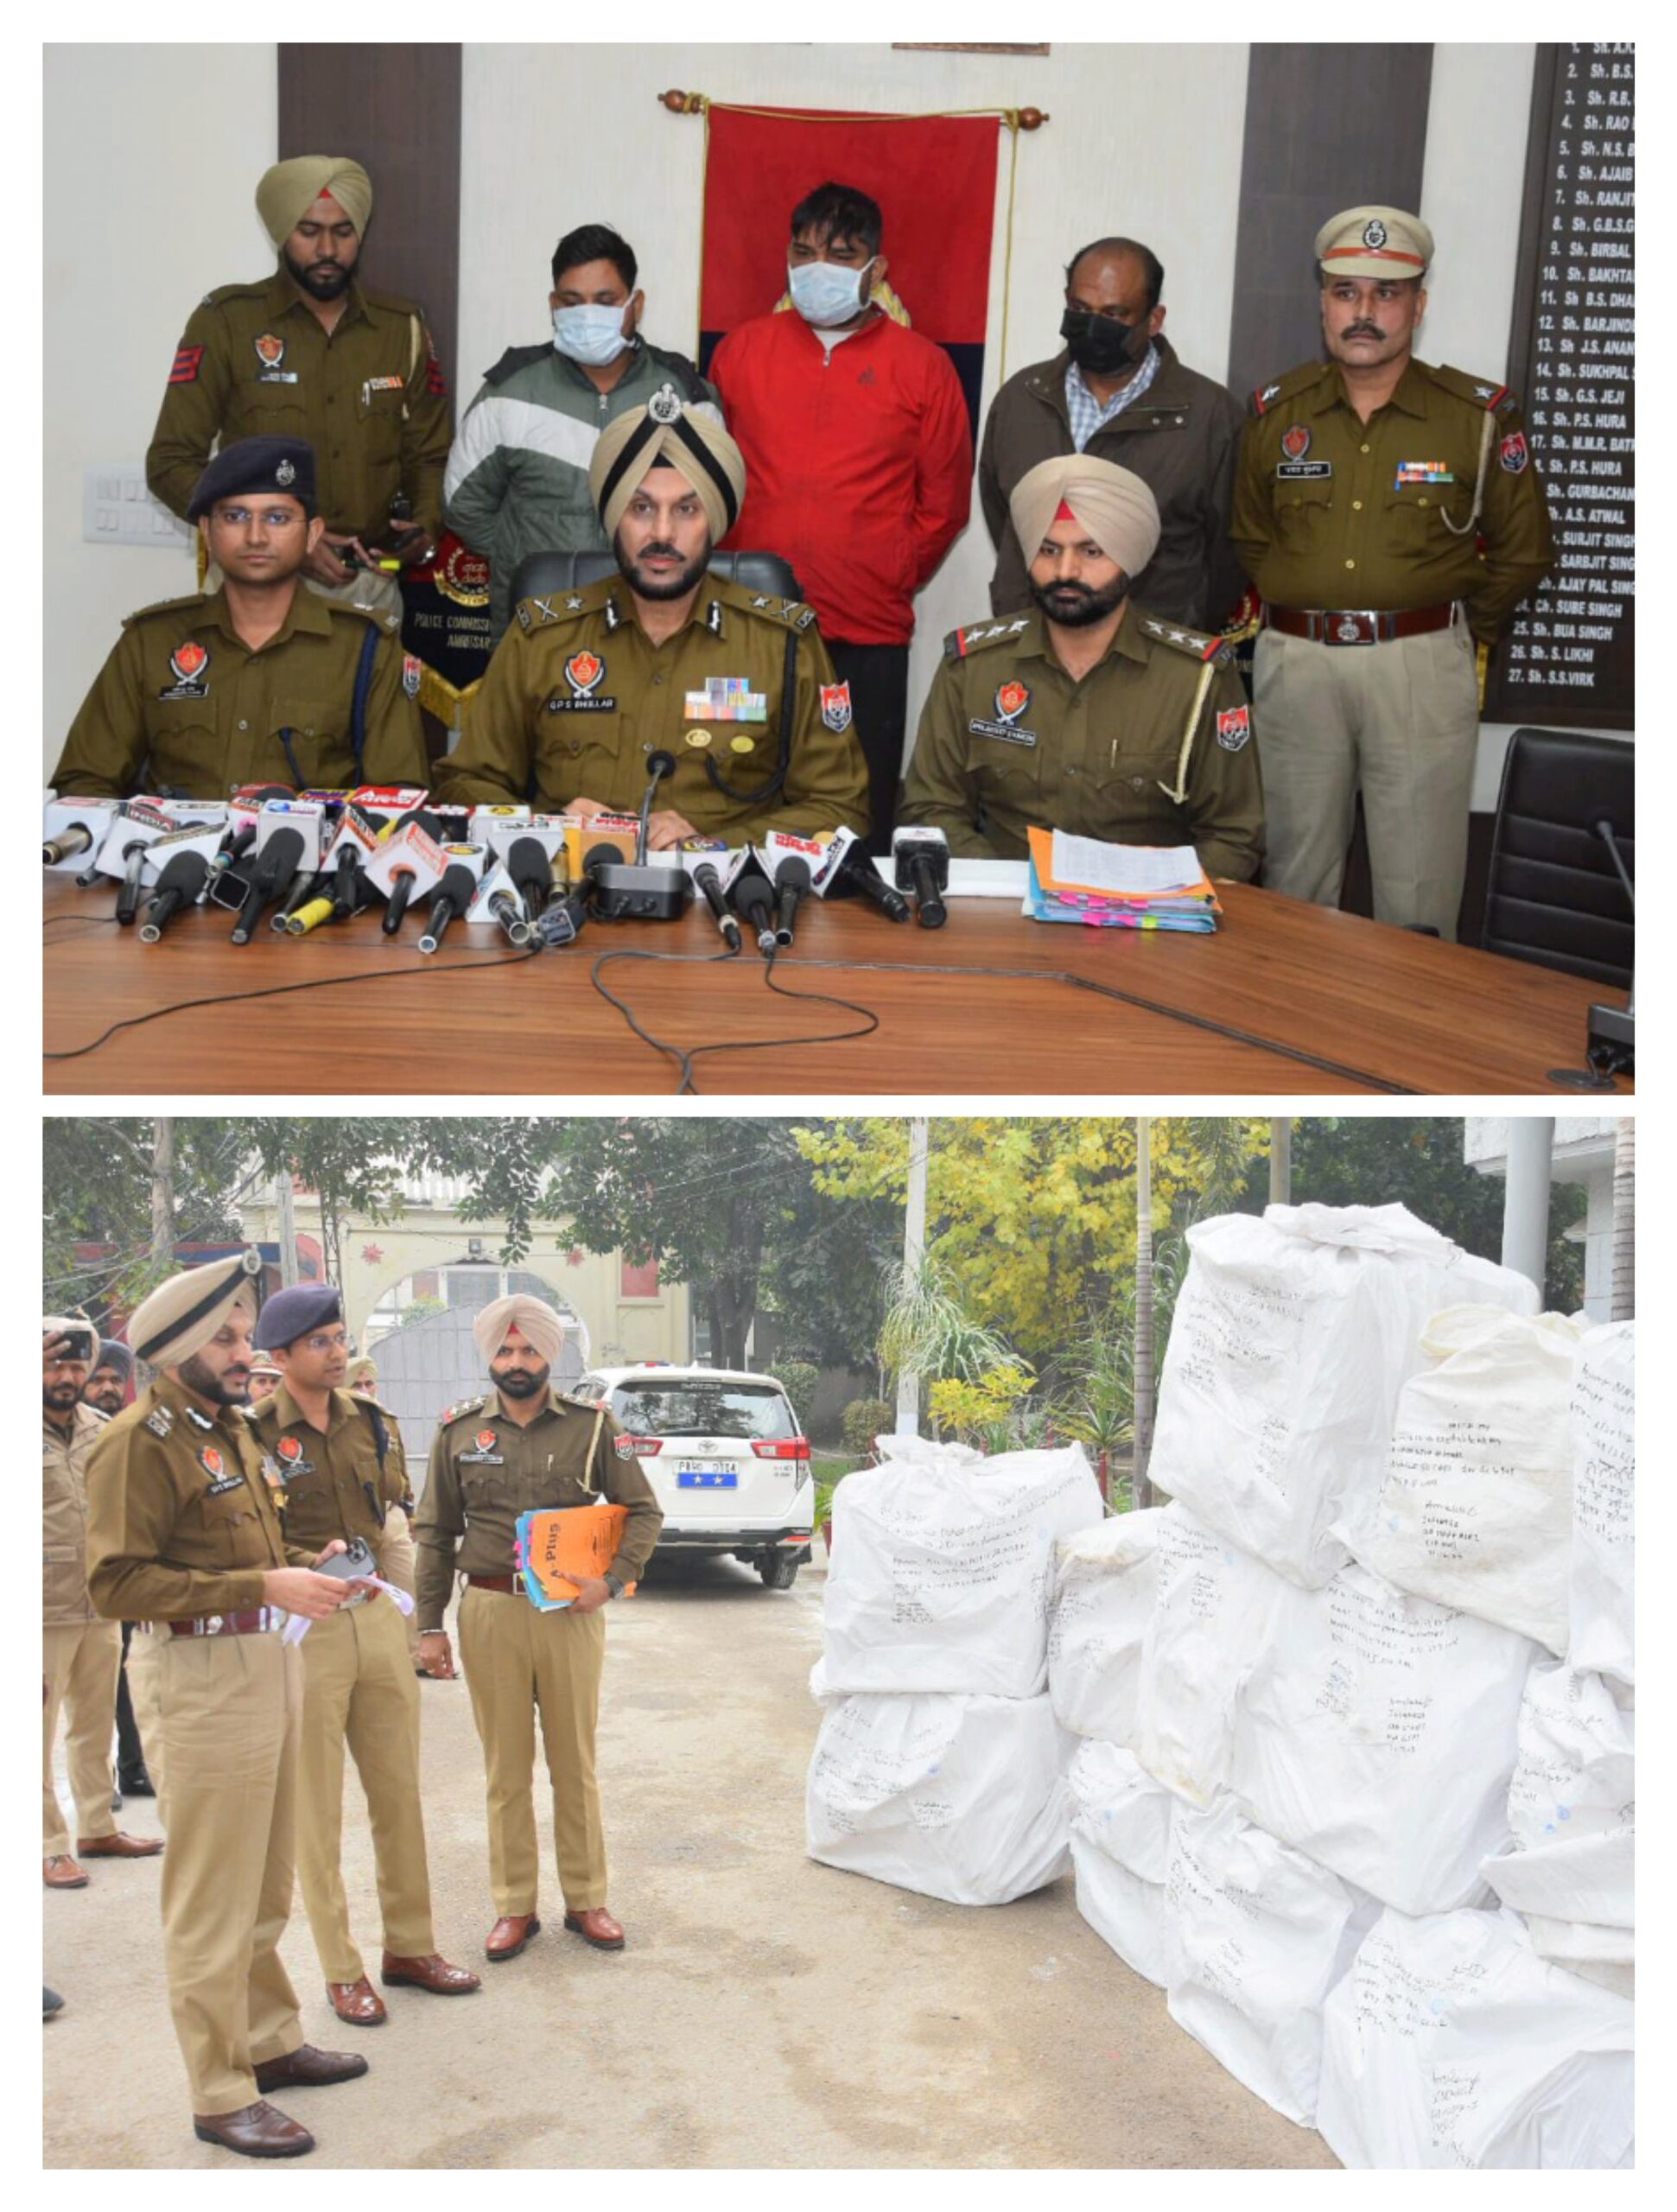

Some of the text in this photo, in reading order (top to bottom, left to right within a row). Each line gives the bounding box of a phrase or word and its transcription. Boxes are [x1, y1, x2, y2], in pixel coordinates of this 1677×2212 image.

[1567, 62, 1634, 79] 2. Sh. B.S.
[1565, 89, 1631, 105] 3. Sh. R.B.
[1561, 114, 1629, 130] 4. Sh. RAO
[1559, 139, 1570, 155] 5.
[1581, 140, 1599, 156] Sh.
[1603, 141, 1624, 156] N.S.
[1556, 164, 1634, 181] 6. Sh. AJAIB
[1555, 189, 1566, 204] 7.
[1575, 189, 1594, 205] Sh.
[1553, 215, 1562, 231] 8.
[1572, 216, 1591, 232] Sh.
[1550, 240, 1631, 258] 9. Sh. BIRBAL
[1542, 266, 1635, 283] 10. Sh. BAKHTA
[1540, 290, 1557, 305] 11.
[1585, 291, 1607, 307] B.S.
[1539, 315, 1554, 330] 12.
[1562, 315, 1579, 331] Sh.
[1537, 337, 1553, 353] 13.
[1580, 339, 1600, 354] J.S.
[1536, 361, 1552, 378] 14.
[1558, 362, 1576, 378] Sh.
[1534, 386, 1550, 401] 15.
[1555, 387, 1573, 403] Sh.
[1576, 388, 1598, 404] G.S.
[1553, 411, 1572, 427] Sh.
[1573, 412, 1593, 428] P.S.
[1530, 435, 1547, 449] 17.
[1552, 435, 1570, 449] Sh.
[1549, 459, 1567, 474] Sh.
[1570, 460, 1589, 474] P.S.
[1547, 483, 1565, 499] Sh.
[1565, 507, 1586, 523] A.S.
[1588, 508, 1627, 524] ATWAL
[1563, 531, 1602, 547] SURJIT
[1560, 554, 1607, 569] SARBJIT
[1558, 576, 1586, 592] AJAY
[1588, 578, 1608, 594] PAL
[1555, 599, 1585, 615] SUBE
[1587, 601, 1623, 618] SINGH
[415, 613, 443, 628] POLICE
[1512, 620, 1613, 641] 25. Sh. BUA SINGH
[1510, 645, 1594, 663] 26. Sh. S. LIKHI
[1508, 668, 1524, 683] 27.
[1528, 669, 1546, 683] Sh.
